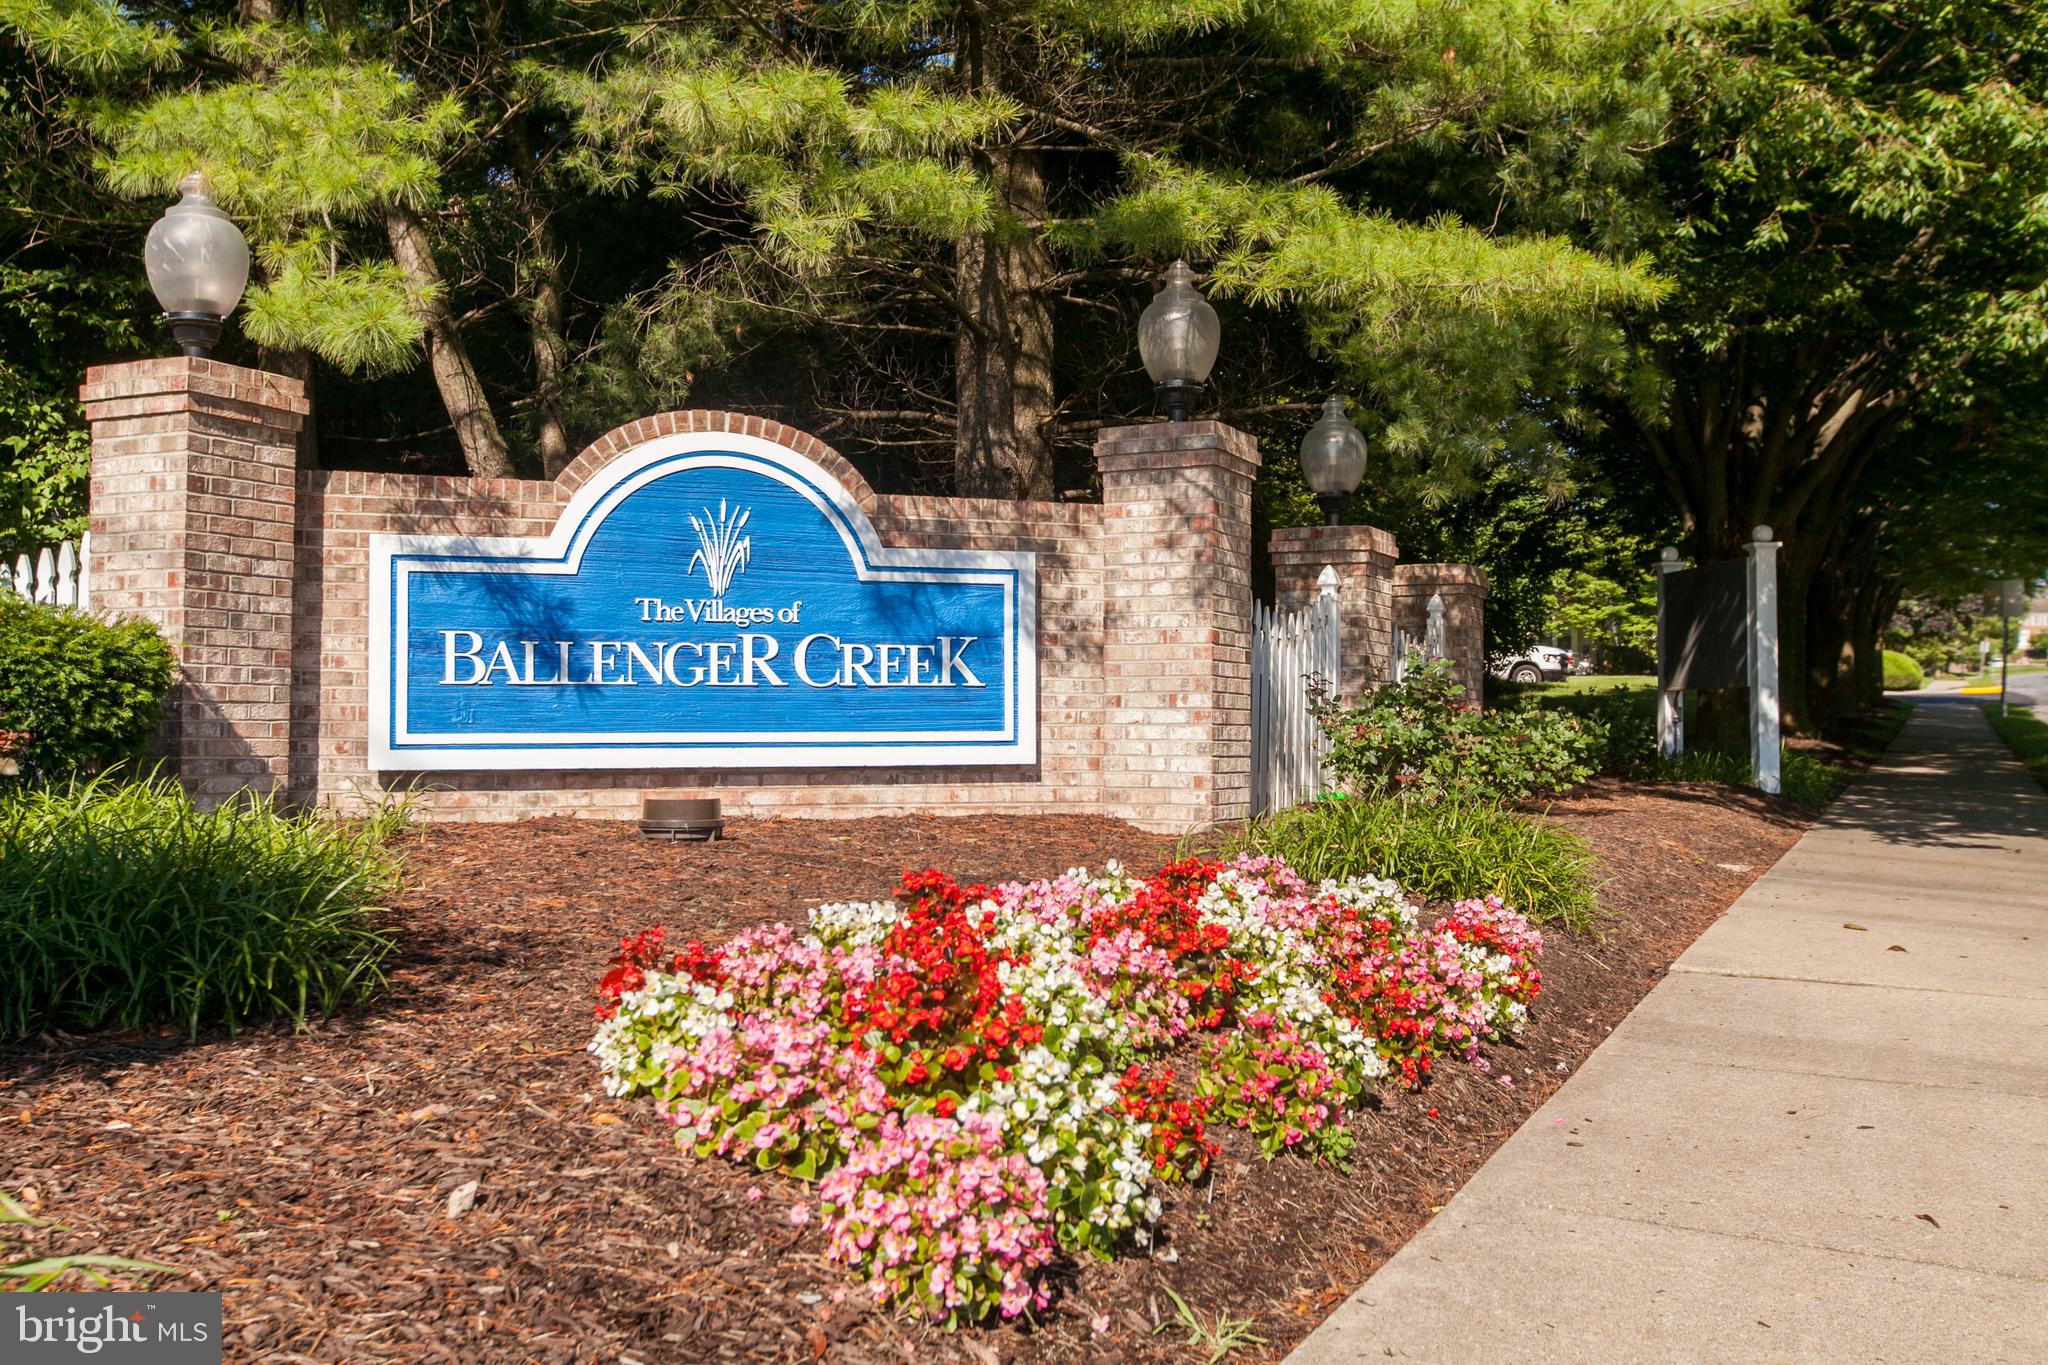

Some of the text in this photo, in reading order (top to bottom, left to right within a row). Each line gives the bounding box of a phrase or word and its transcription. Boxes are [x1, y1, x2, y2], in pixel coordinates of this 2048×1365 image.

[635, 598, 802, 626] The Villages of
[439, 630, 986, 687] BALLENGER CREEK
